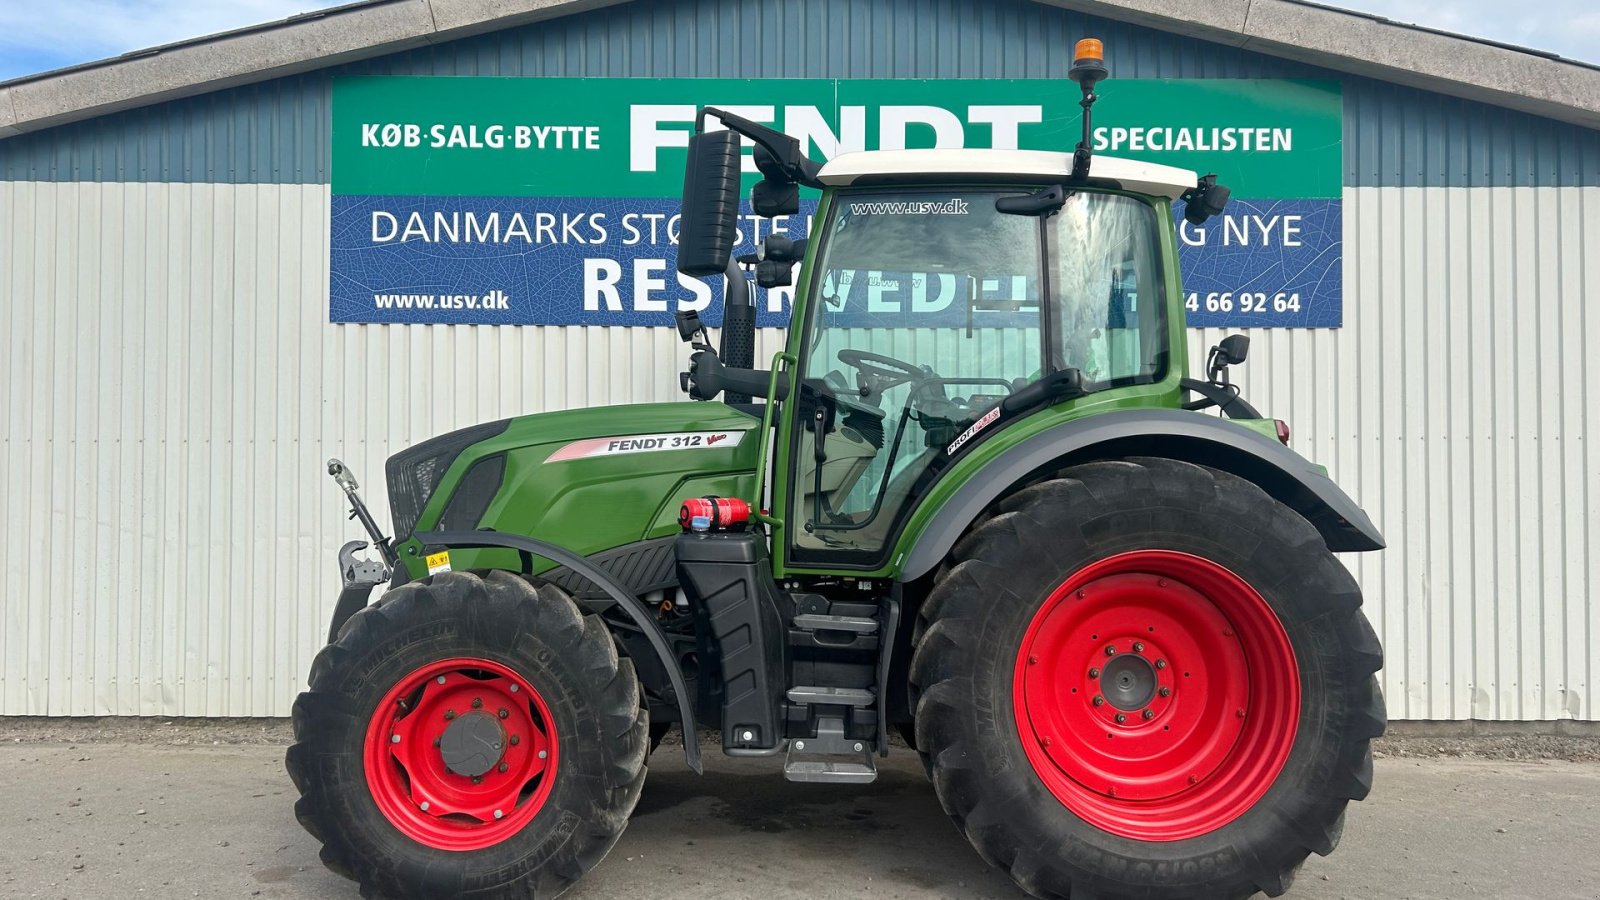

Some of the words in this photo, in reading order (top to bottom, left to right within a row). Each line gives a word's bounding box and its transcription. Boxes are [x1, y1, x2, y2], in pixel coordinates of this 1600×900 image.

[1093, 126, 1293, 153] SPECIALISTEN
[851, 199, 969, 216] www.usv.dk
[371, 211, 608, 245] DANMARKS
[621, 214, 791, 246] STTE
[1223, 214, 1302, 247] NYE
[374, 290, 509, 310] www.usv.dk
[1182, 292, 1199, 312] 4
[1206, 292, 1233, 312] 66
[1239, 292, 1267, 313] 92
[1273, 292, 1301, 313] 64
[608, 438, 667, 451] FENDT
[671, 436, 702, 447] 312
